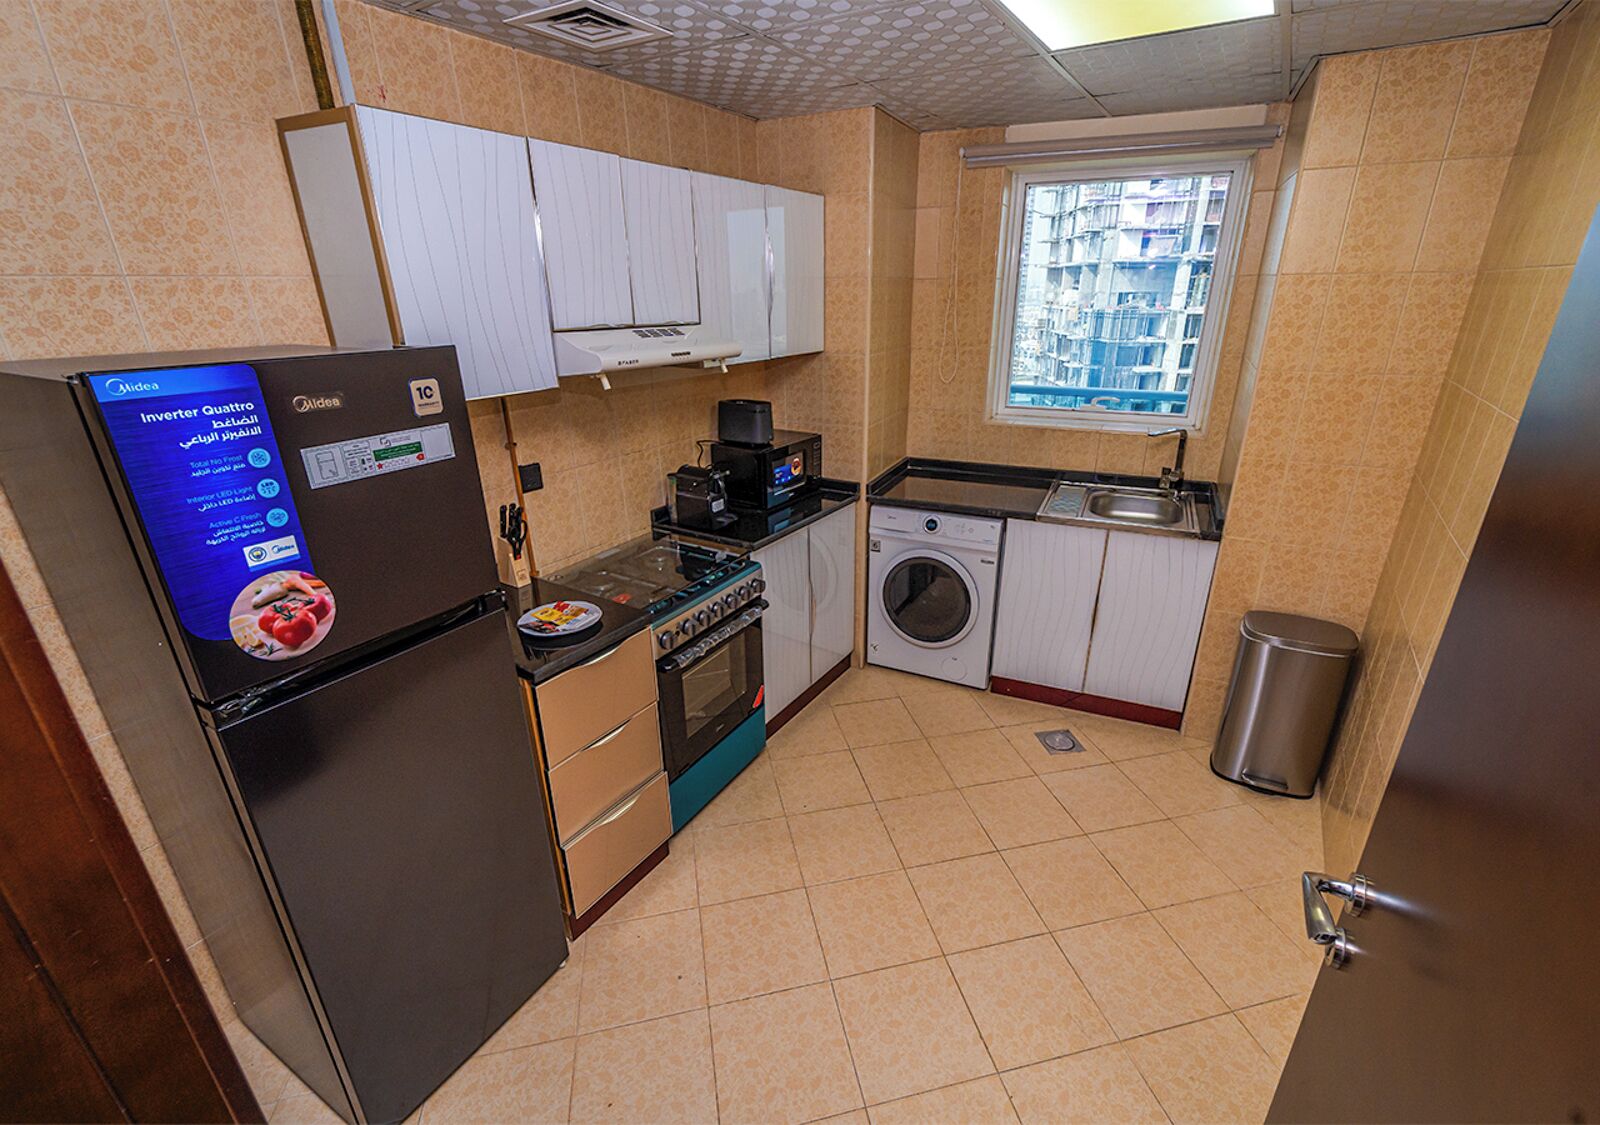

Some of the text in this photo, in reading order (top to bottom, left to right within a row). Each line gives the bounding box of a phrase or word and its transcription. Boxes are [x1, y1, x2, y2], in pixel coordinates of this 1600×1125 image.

[105, 378, 159, 396] Midea
[140, 401, 255, 424] Inverter Quattro
[292, 395, 340, 413] Midea
[211, 415, 259, 429] الضاغط
[179, 433, 219, 450] الرباعي
[190, 461, 209, 469] Total
[223, 454, 242, 463] Frost
[186, 486, 252, 504] Interior LED Light
[218, 498, 234, 507] LED
[209, 512, 262, 529] Active C Fresh
